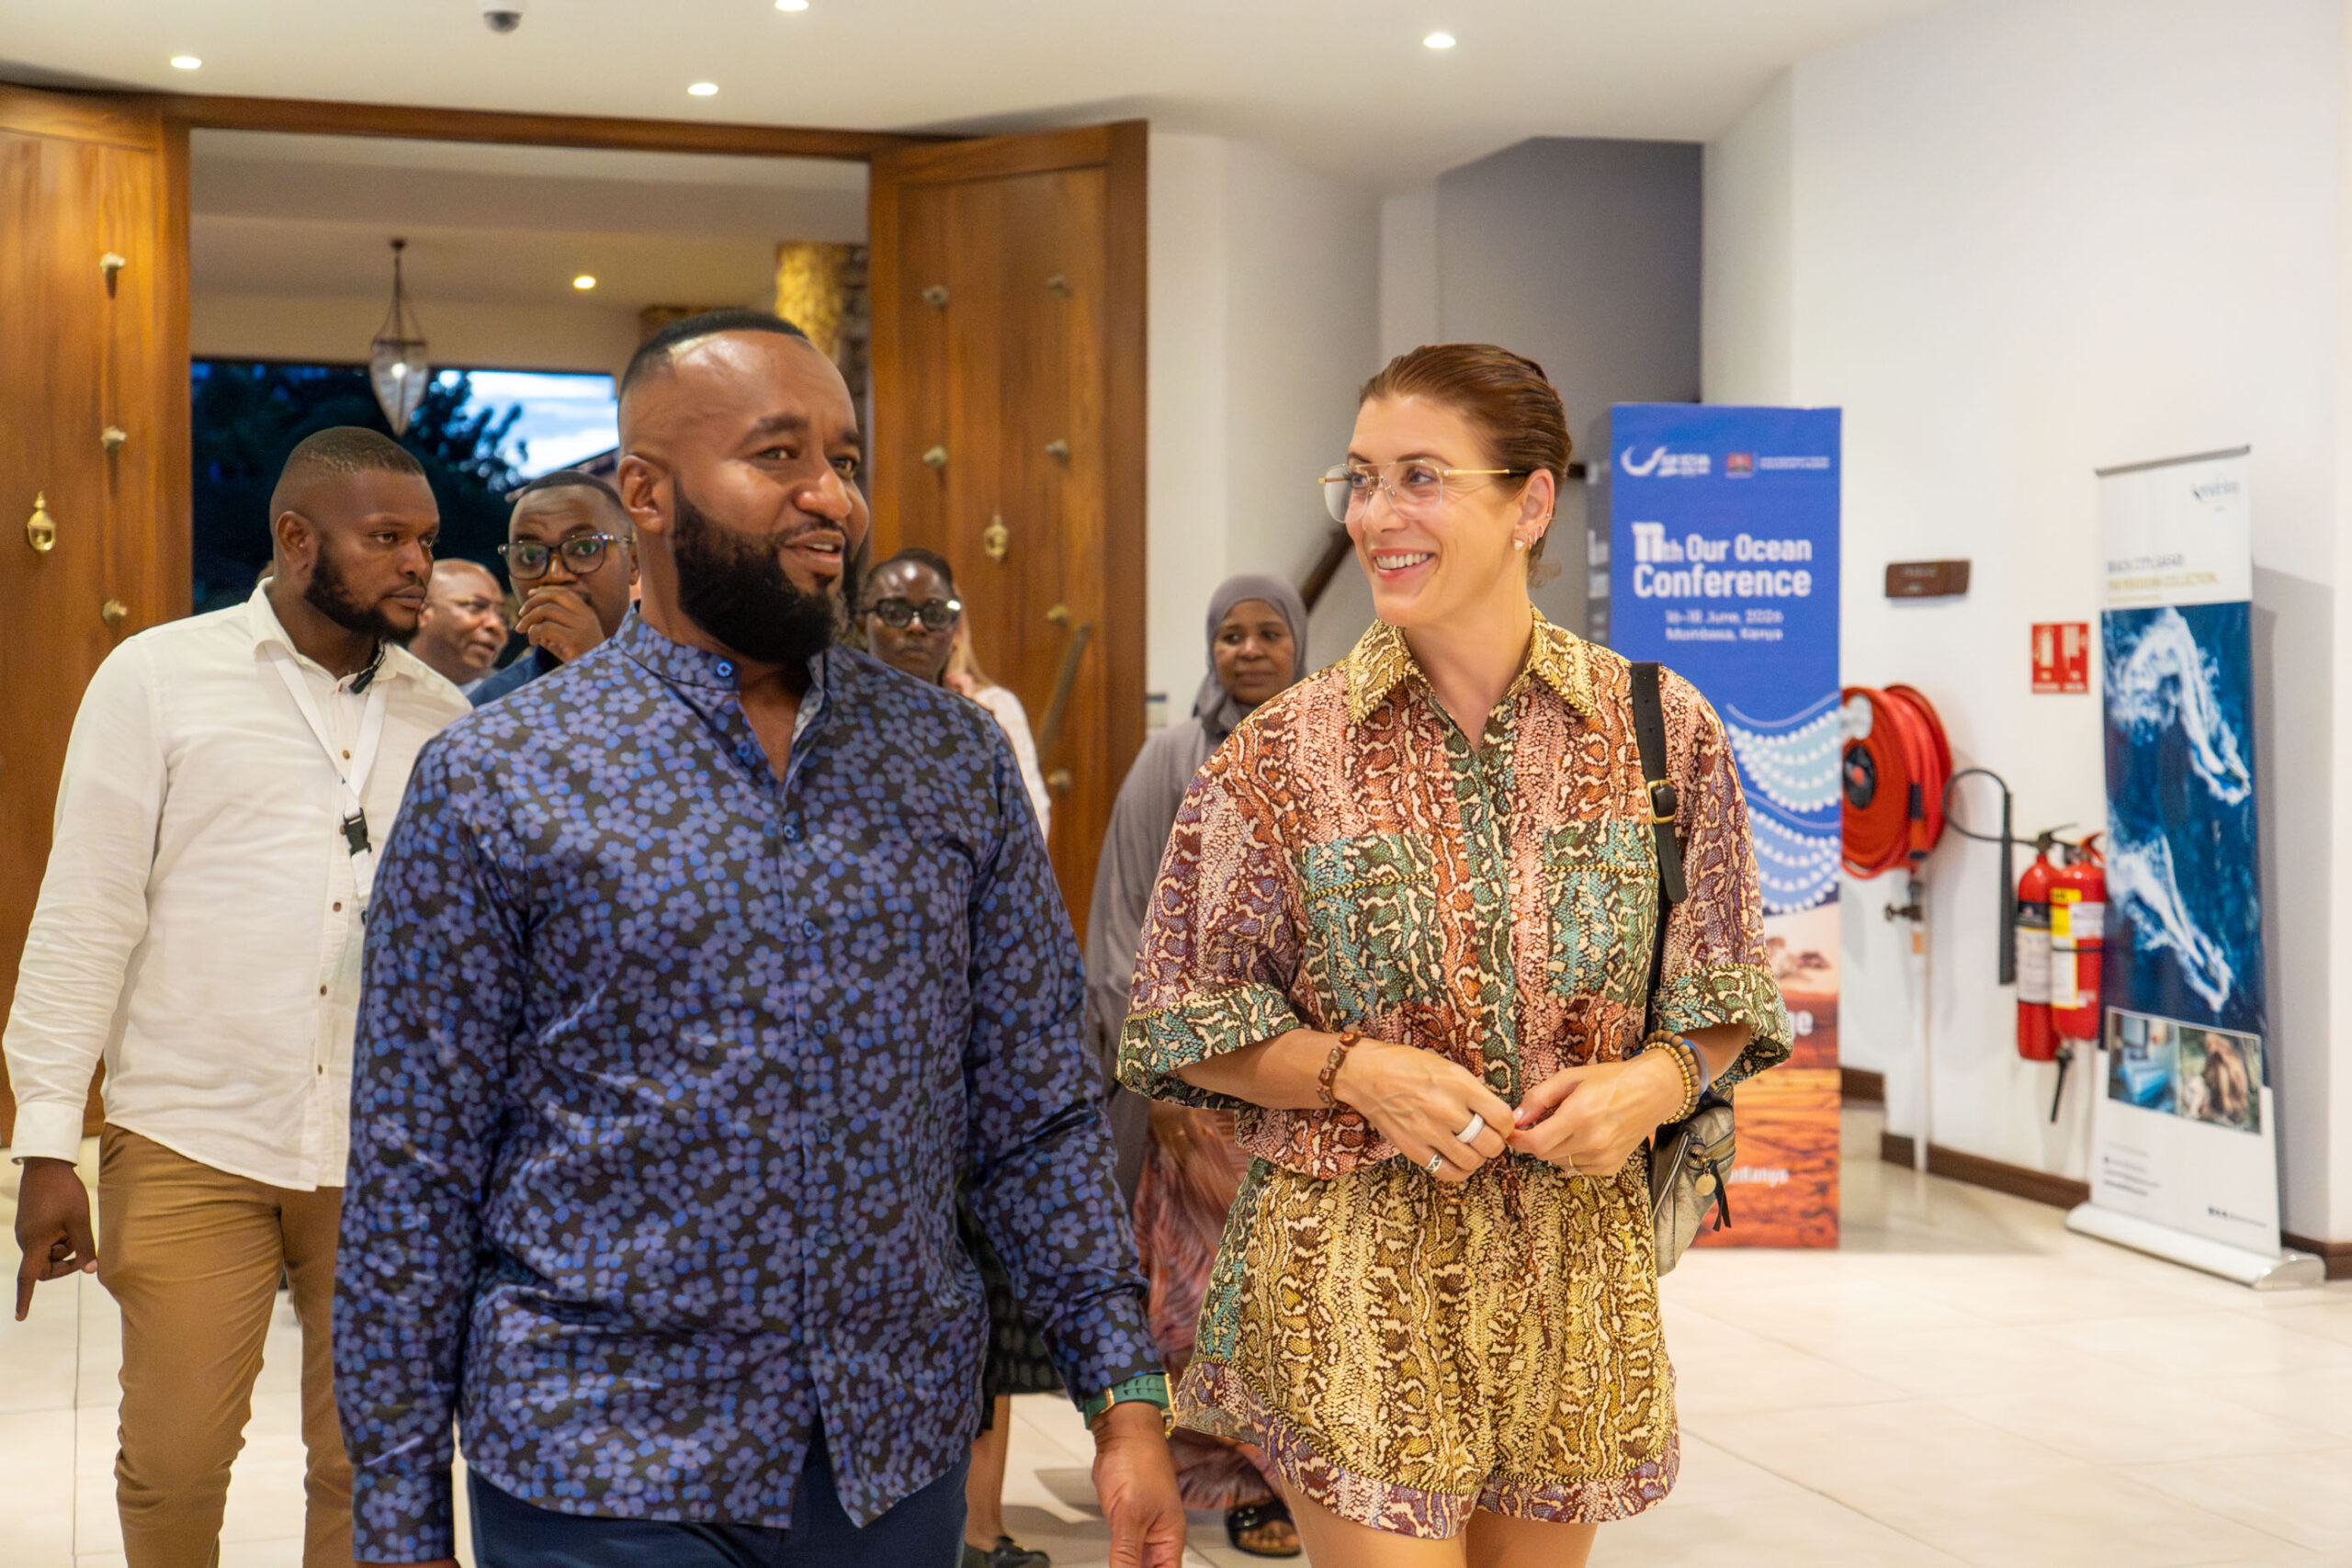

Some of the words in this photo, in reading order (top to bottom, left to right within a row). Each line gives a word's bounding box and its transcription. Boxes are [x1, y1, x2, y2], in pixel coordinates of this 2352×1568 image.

[1686, 534, 1730, 562] Our
[1735, 534, 1813, 562] Ocean
[1634, 562, 1813, 598] Conference
